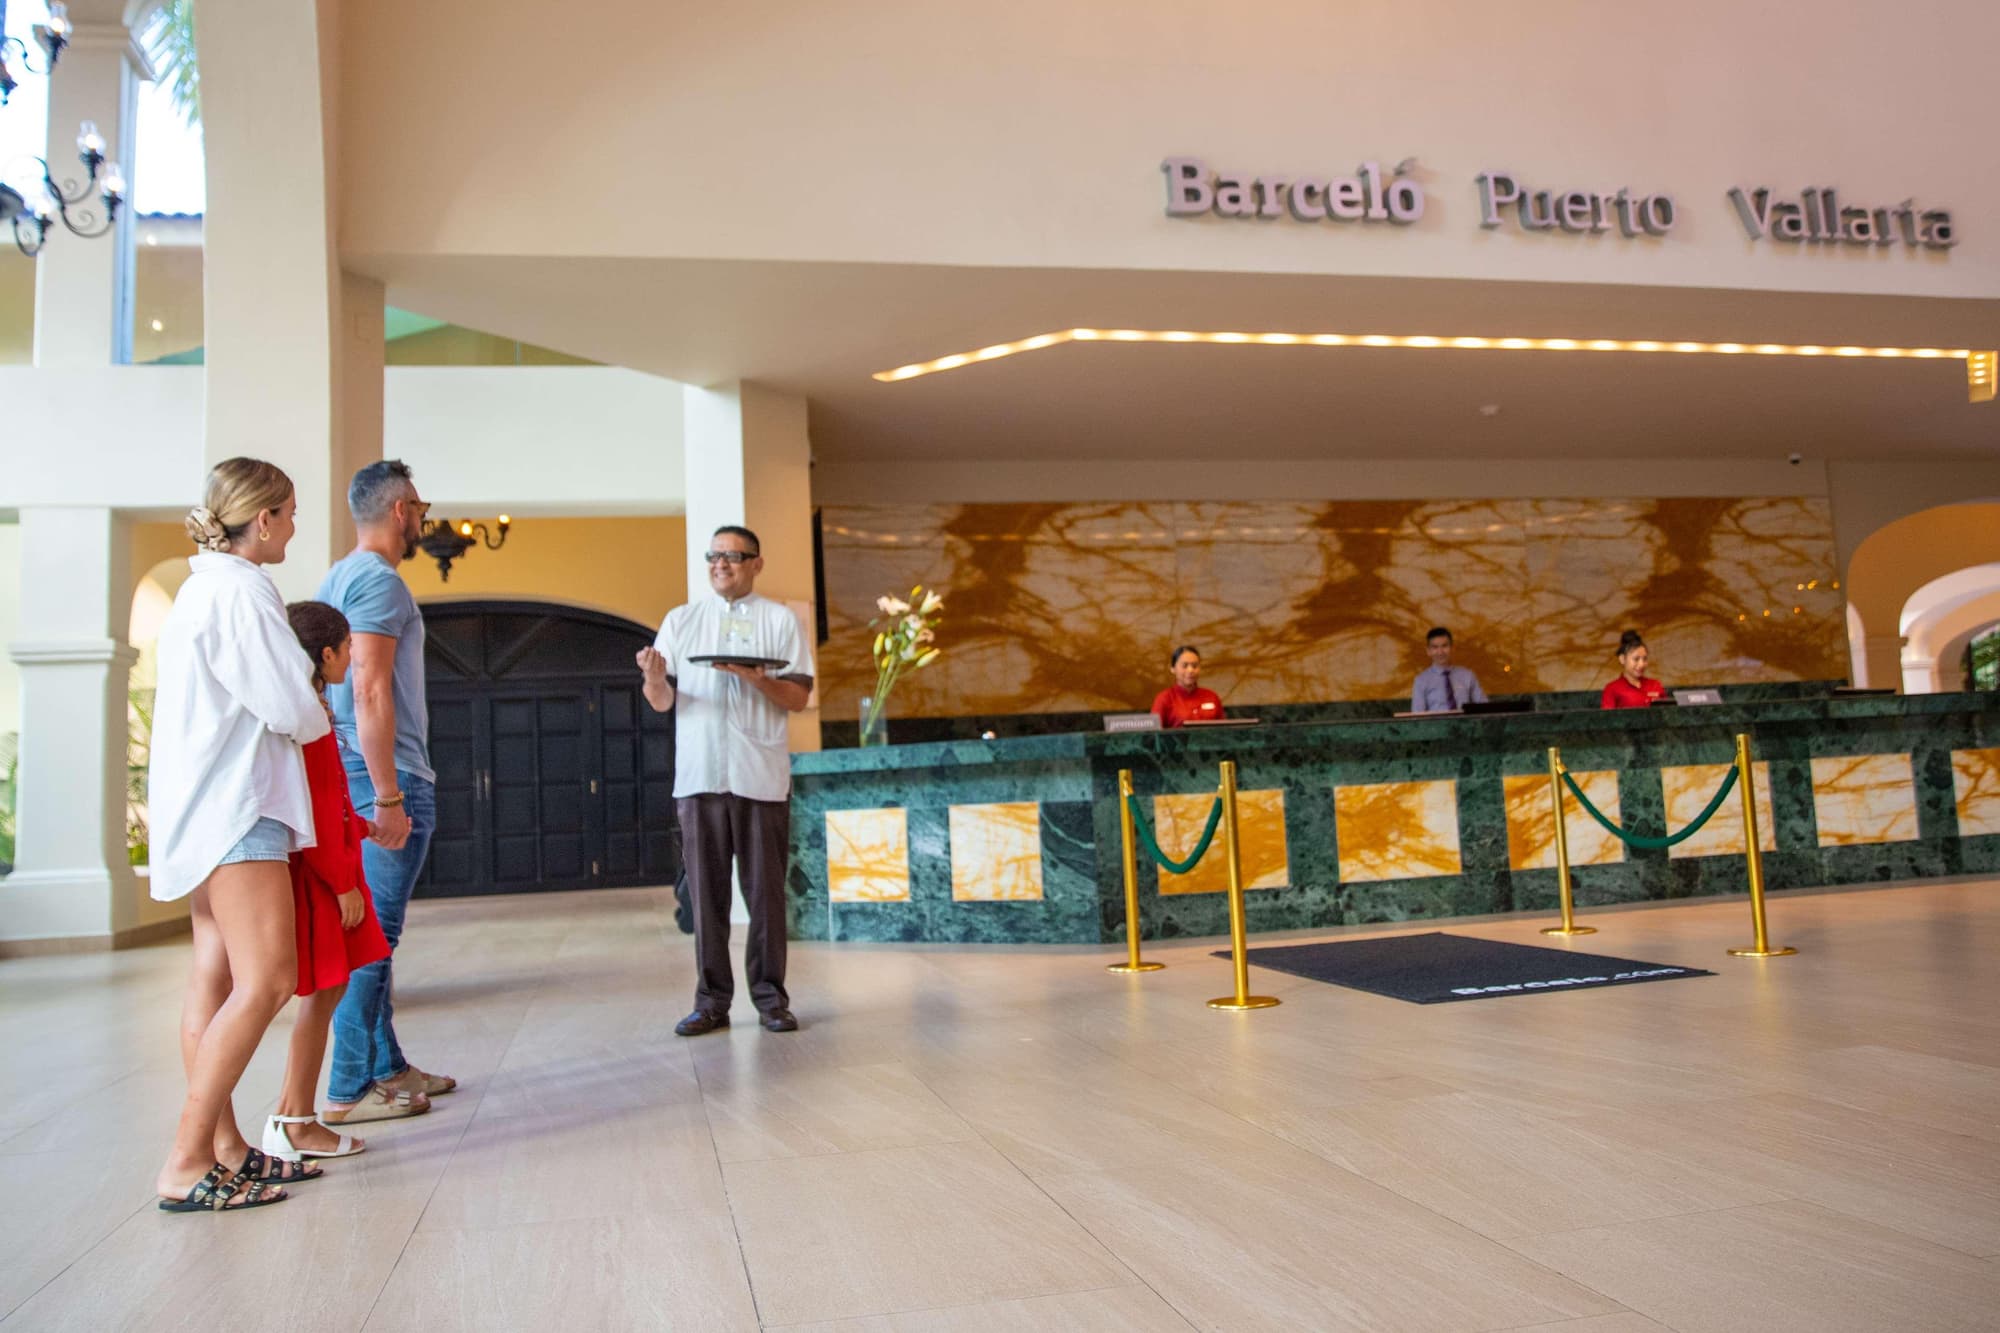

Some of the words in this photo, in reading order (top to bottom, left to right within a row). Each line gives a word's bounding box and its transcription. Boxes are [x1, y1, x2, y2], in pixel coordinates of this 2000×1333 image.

[1161, 156, 1425, 226] Barceló
[1475, 168, 1675, 238] Puerto
[1727, 184, 1958, 250] Vallarta
